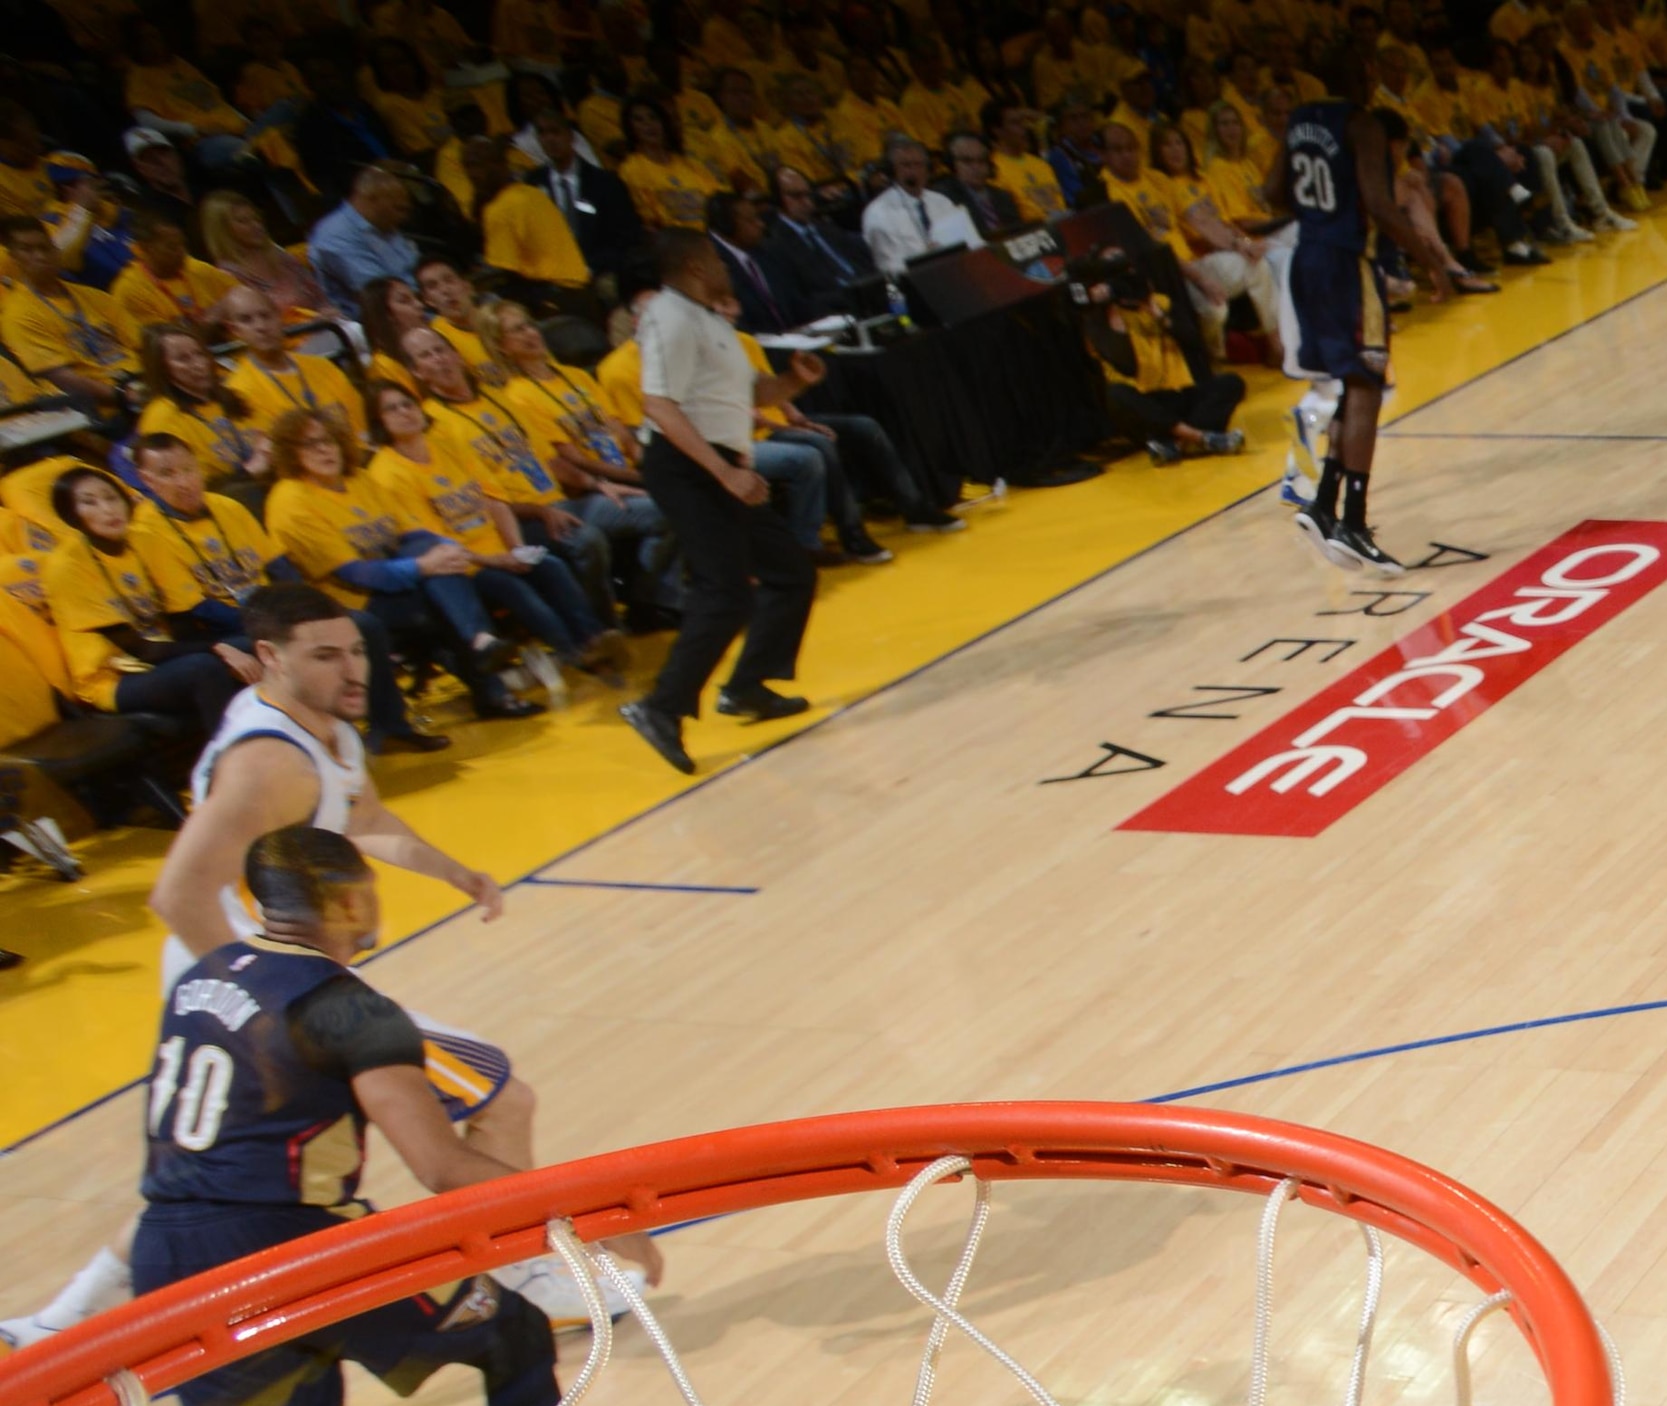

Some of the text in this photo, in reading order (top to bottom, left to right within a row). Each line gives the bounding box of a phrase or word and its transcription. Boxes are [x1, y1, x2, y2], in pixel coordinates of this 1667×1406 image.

[1291, 152, 1338, 213] 20
[1038, 541, 1492, 785] ARENA
[1224, 542, 1661, 798] ORACLE
[150, 1036, 234, 1152] 10
